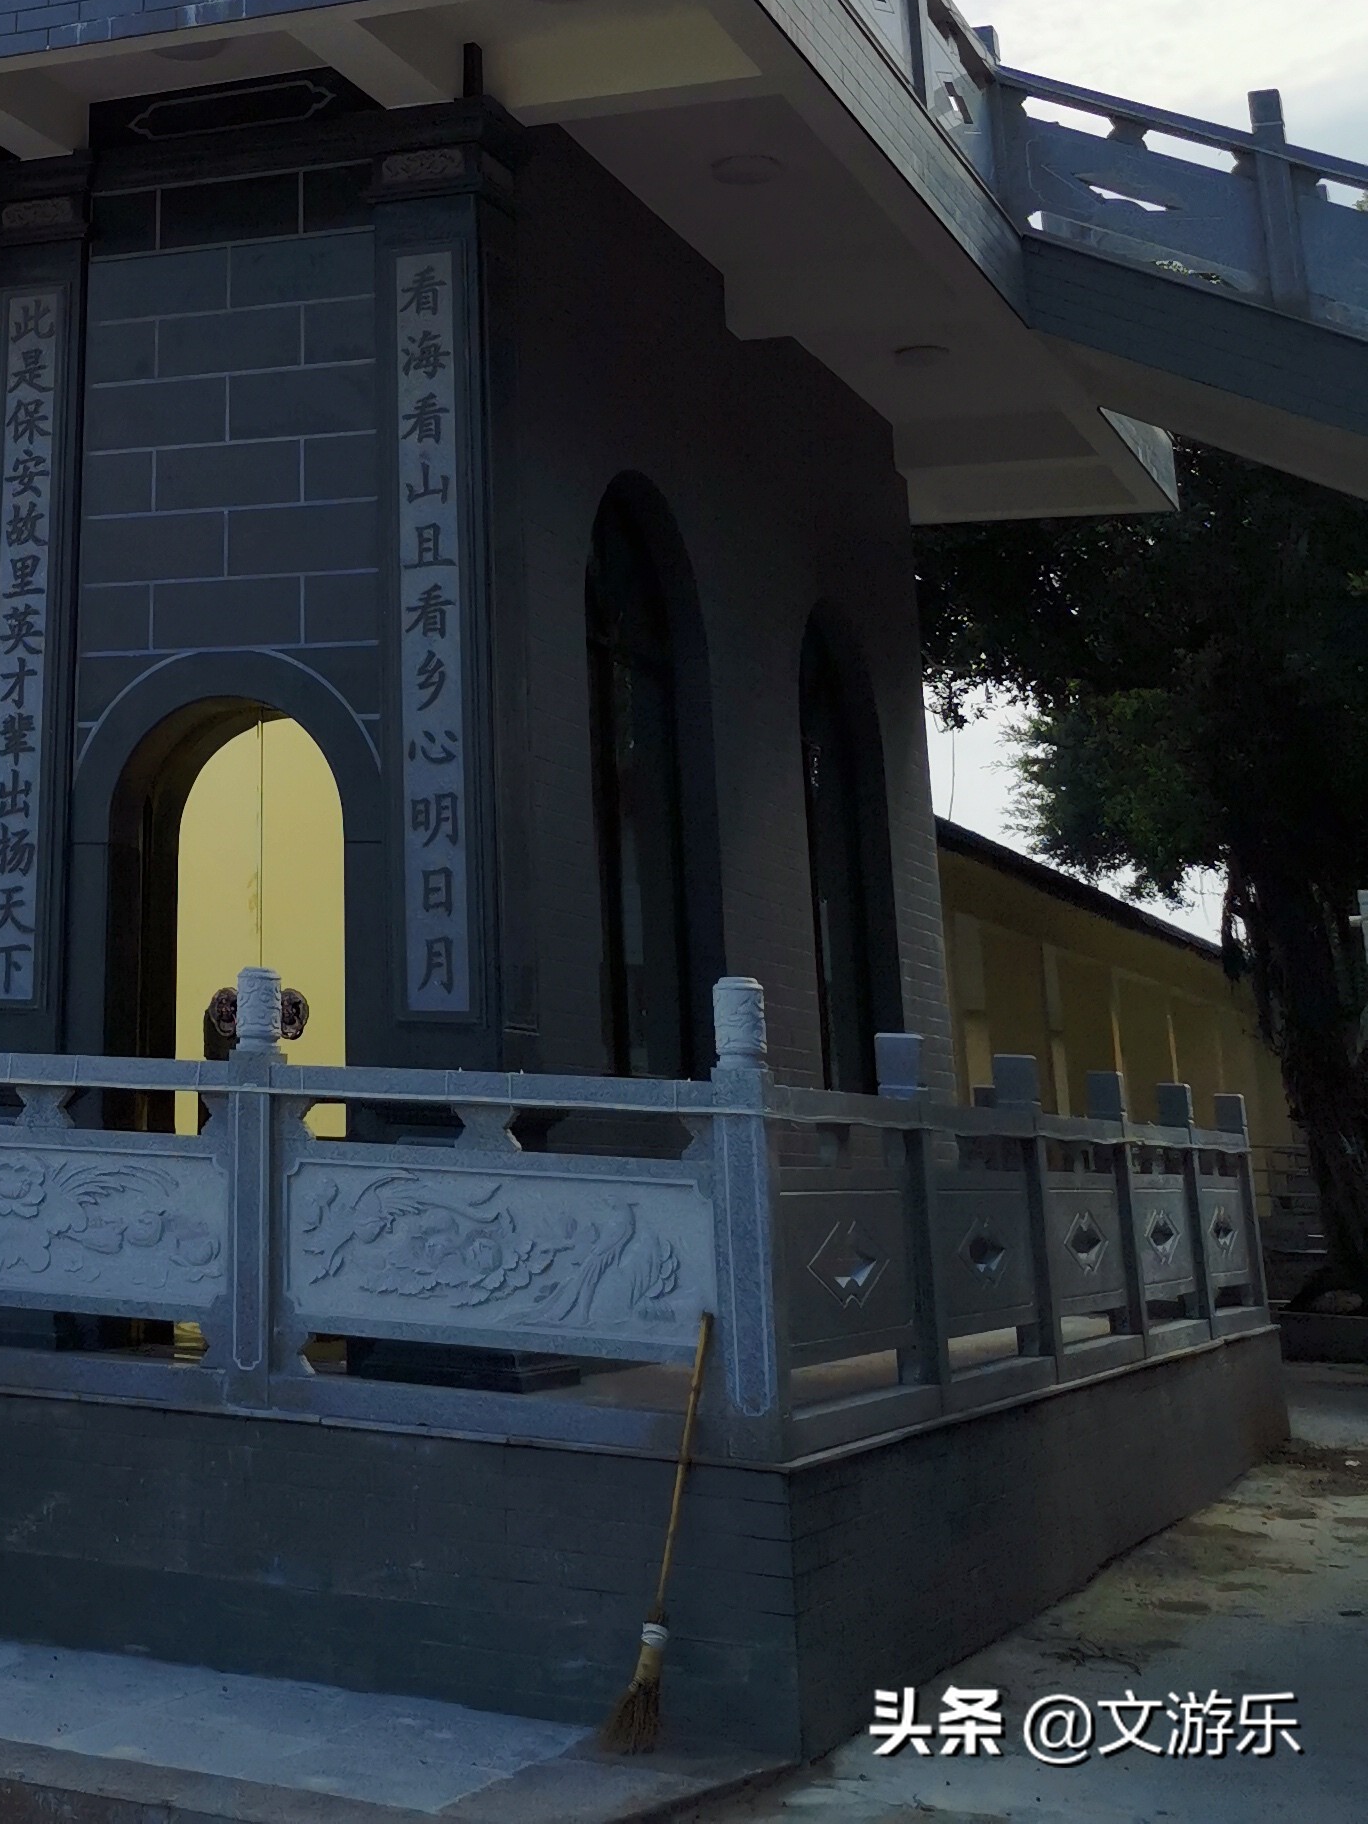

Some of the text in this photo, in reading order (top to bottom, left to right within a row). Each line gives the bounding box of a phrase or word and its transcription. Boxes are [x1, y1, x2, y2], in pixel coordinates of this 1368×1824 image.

[399, 265, 460, 994] 看海看山且看乡心明日月
